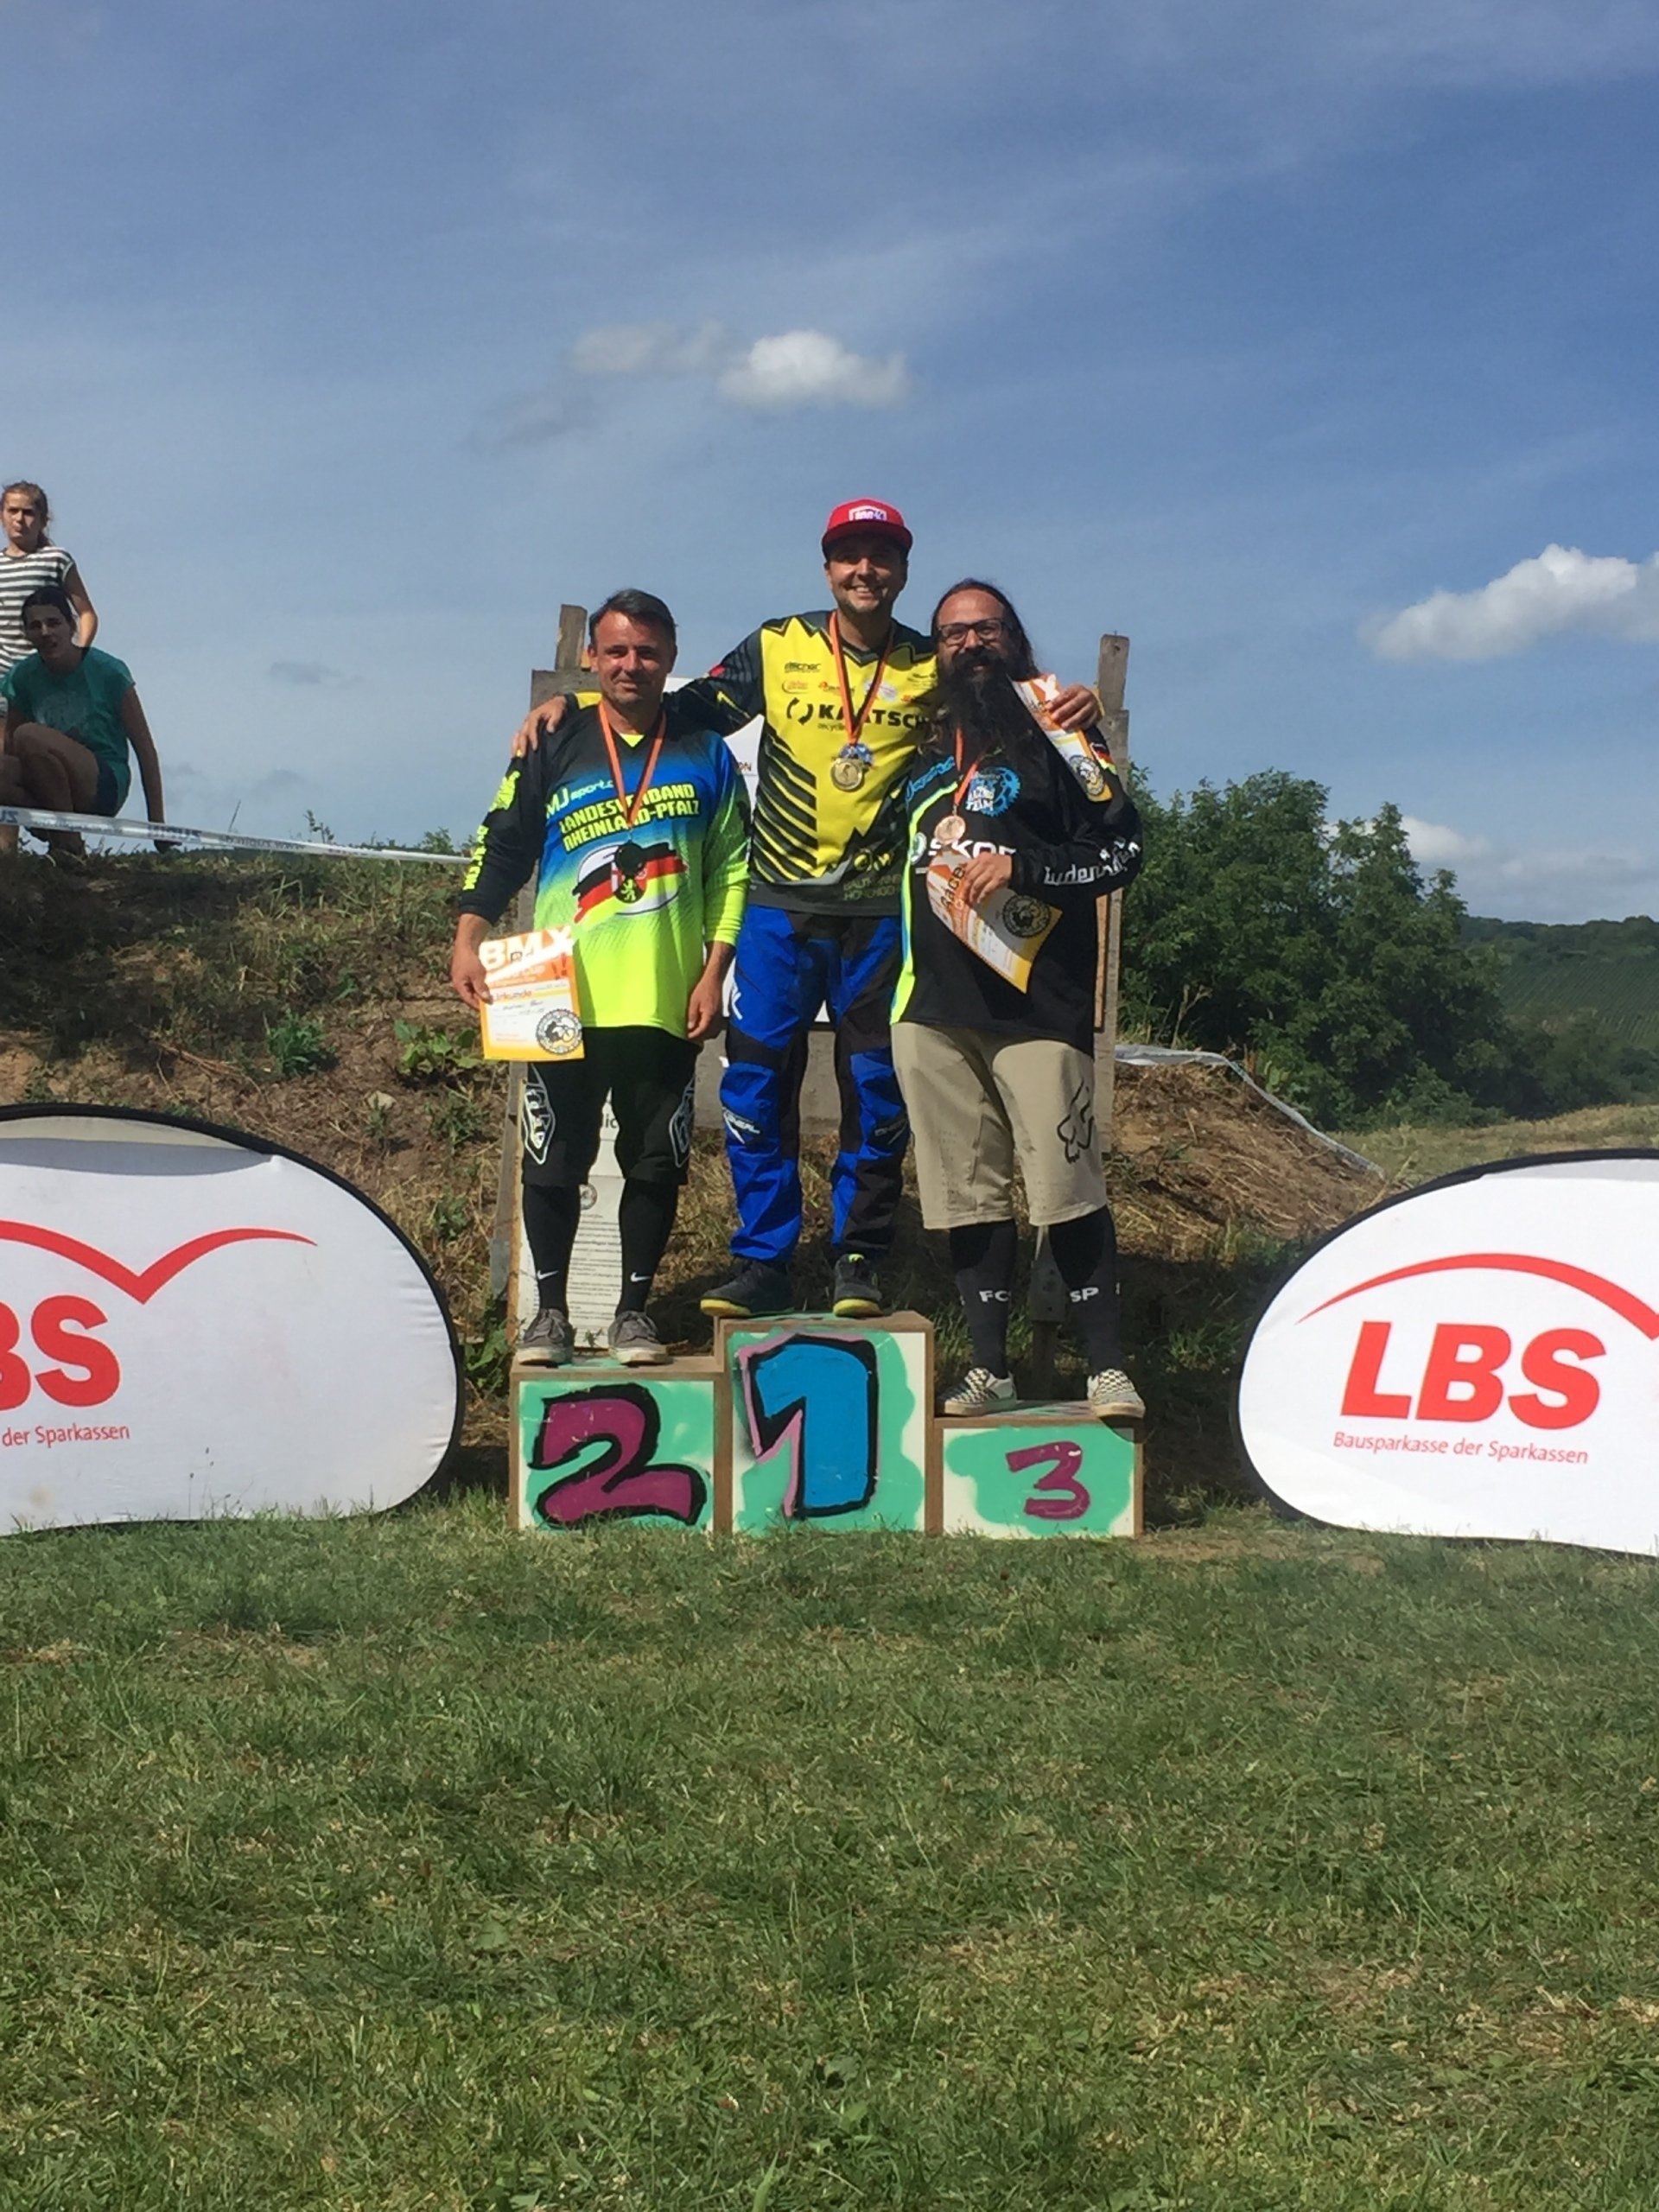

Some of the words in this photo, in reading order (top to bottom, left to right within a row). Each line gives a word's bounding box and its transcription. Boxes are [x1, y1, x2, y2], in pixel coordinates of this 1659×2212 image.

[479, 925, 574, 970] BMX
[1341, 1321, 1606, 1430] LBS
[2, 1428, 30, 1446] der
[35, 1424, 130, 1447] Sparkassen
[526, 1383, 709, 1527] 2
[1332, 1432, 1449, 1454] Bausparkasse
[1452, 1438, 1484, 1456] der
[1488, 1440, 1589, 1465] Sparkassen
[1005, 1441, 1091, 1521] 3
